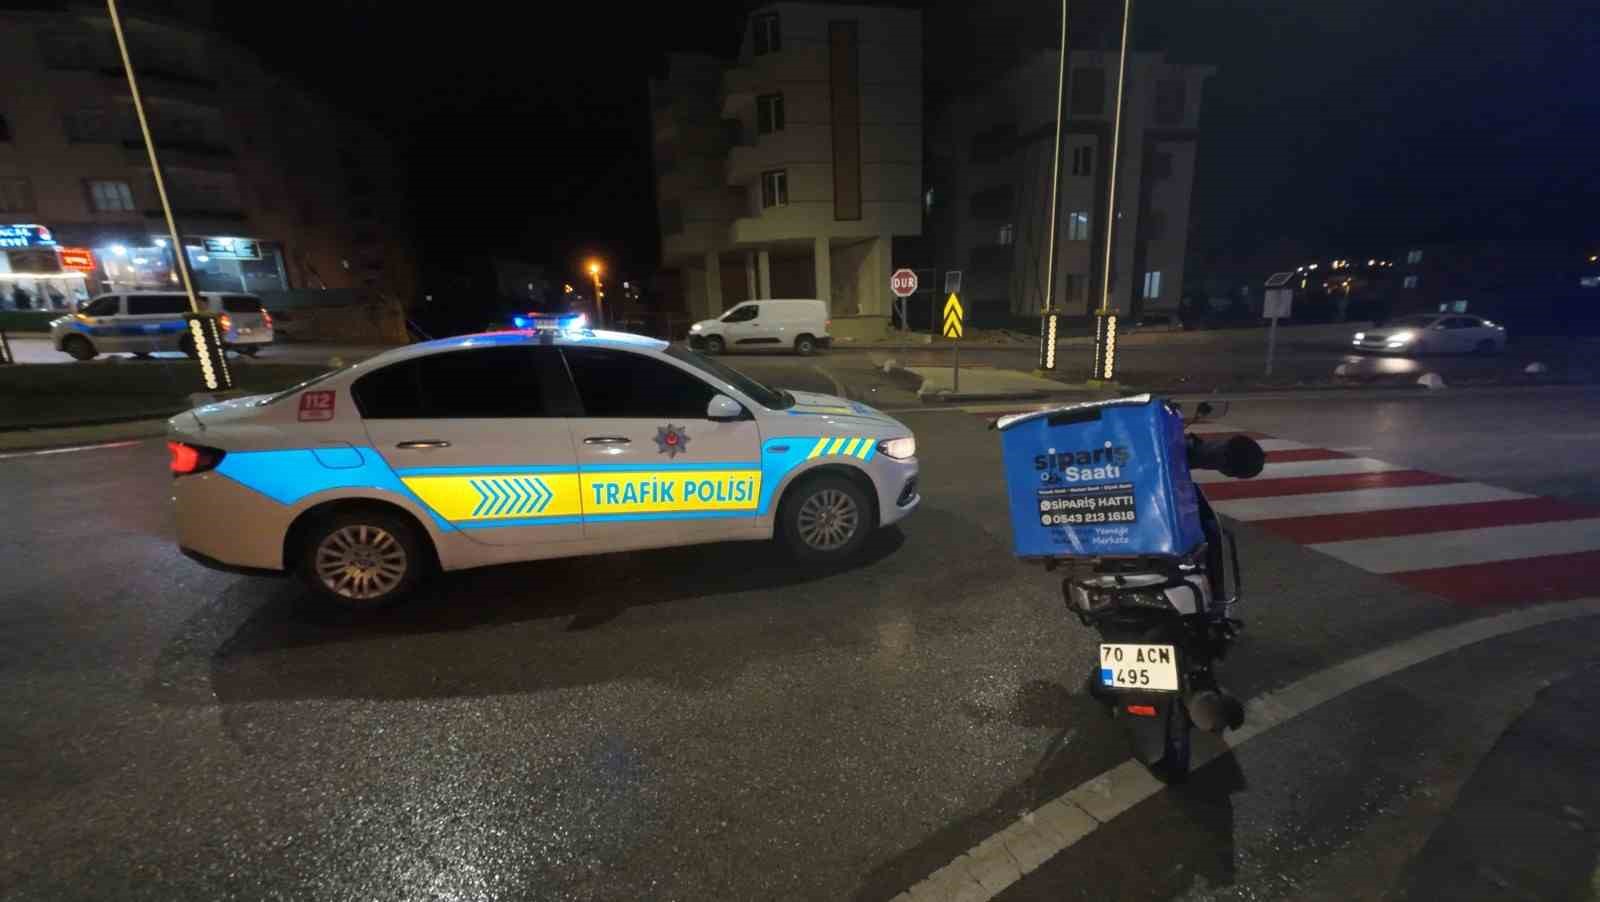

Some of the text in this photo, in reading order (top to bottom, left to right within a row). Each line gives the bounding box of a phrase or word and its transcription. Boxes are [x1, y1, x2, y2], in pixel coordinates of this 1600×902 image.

[894, 277, 914, 289] DUR
[305, 394, 330, 409] 112
[1034, 441, 1129, 472] sipariş
[592, 476, 754, 504] TRAFİK POLİSİ
[1052, 495, 1133, 510] SİPARİŞ HATTI
[1052, 513, 1083, 524] 0543
[1085, 512, 1105, 522] 213
[1102, 647, 1170, 664] 70 ACN
[1117, 669, 1150, 685] 495
